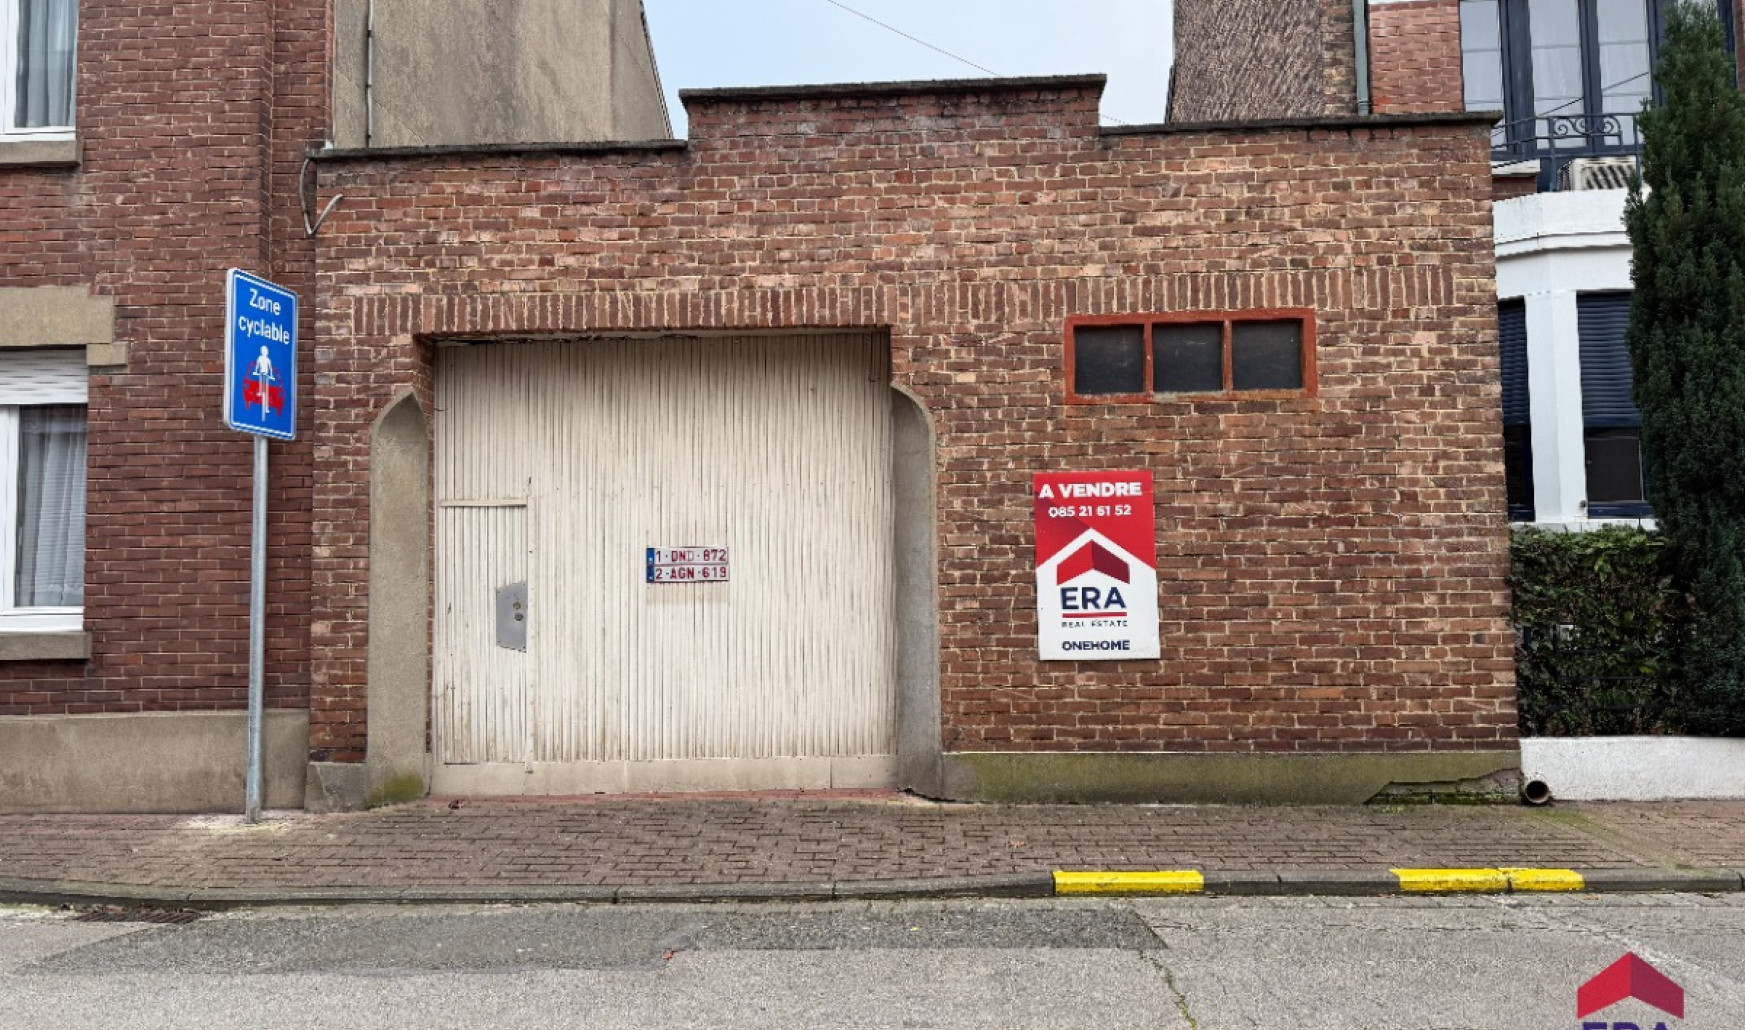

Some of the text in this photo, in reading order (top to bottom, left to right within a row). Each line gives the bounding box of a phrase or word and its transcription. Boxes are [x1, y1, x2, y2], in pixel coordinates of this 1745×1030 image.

[249, 287, 281, 316] Zone
[238, 316, 290, 345] cyclable
[1039, 481, 1143, 498] A VENDRE
[1048, 504, 1132, 518] 085 21 61 52
[1060, 586, 1127, 610] ERA
[1062, 640, 1130, 651] ONEHOME
